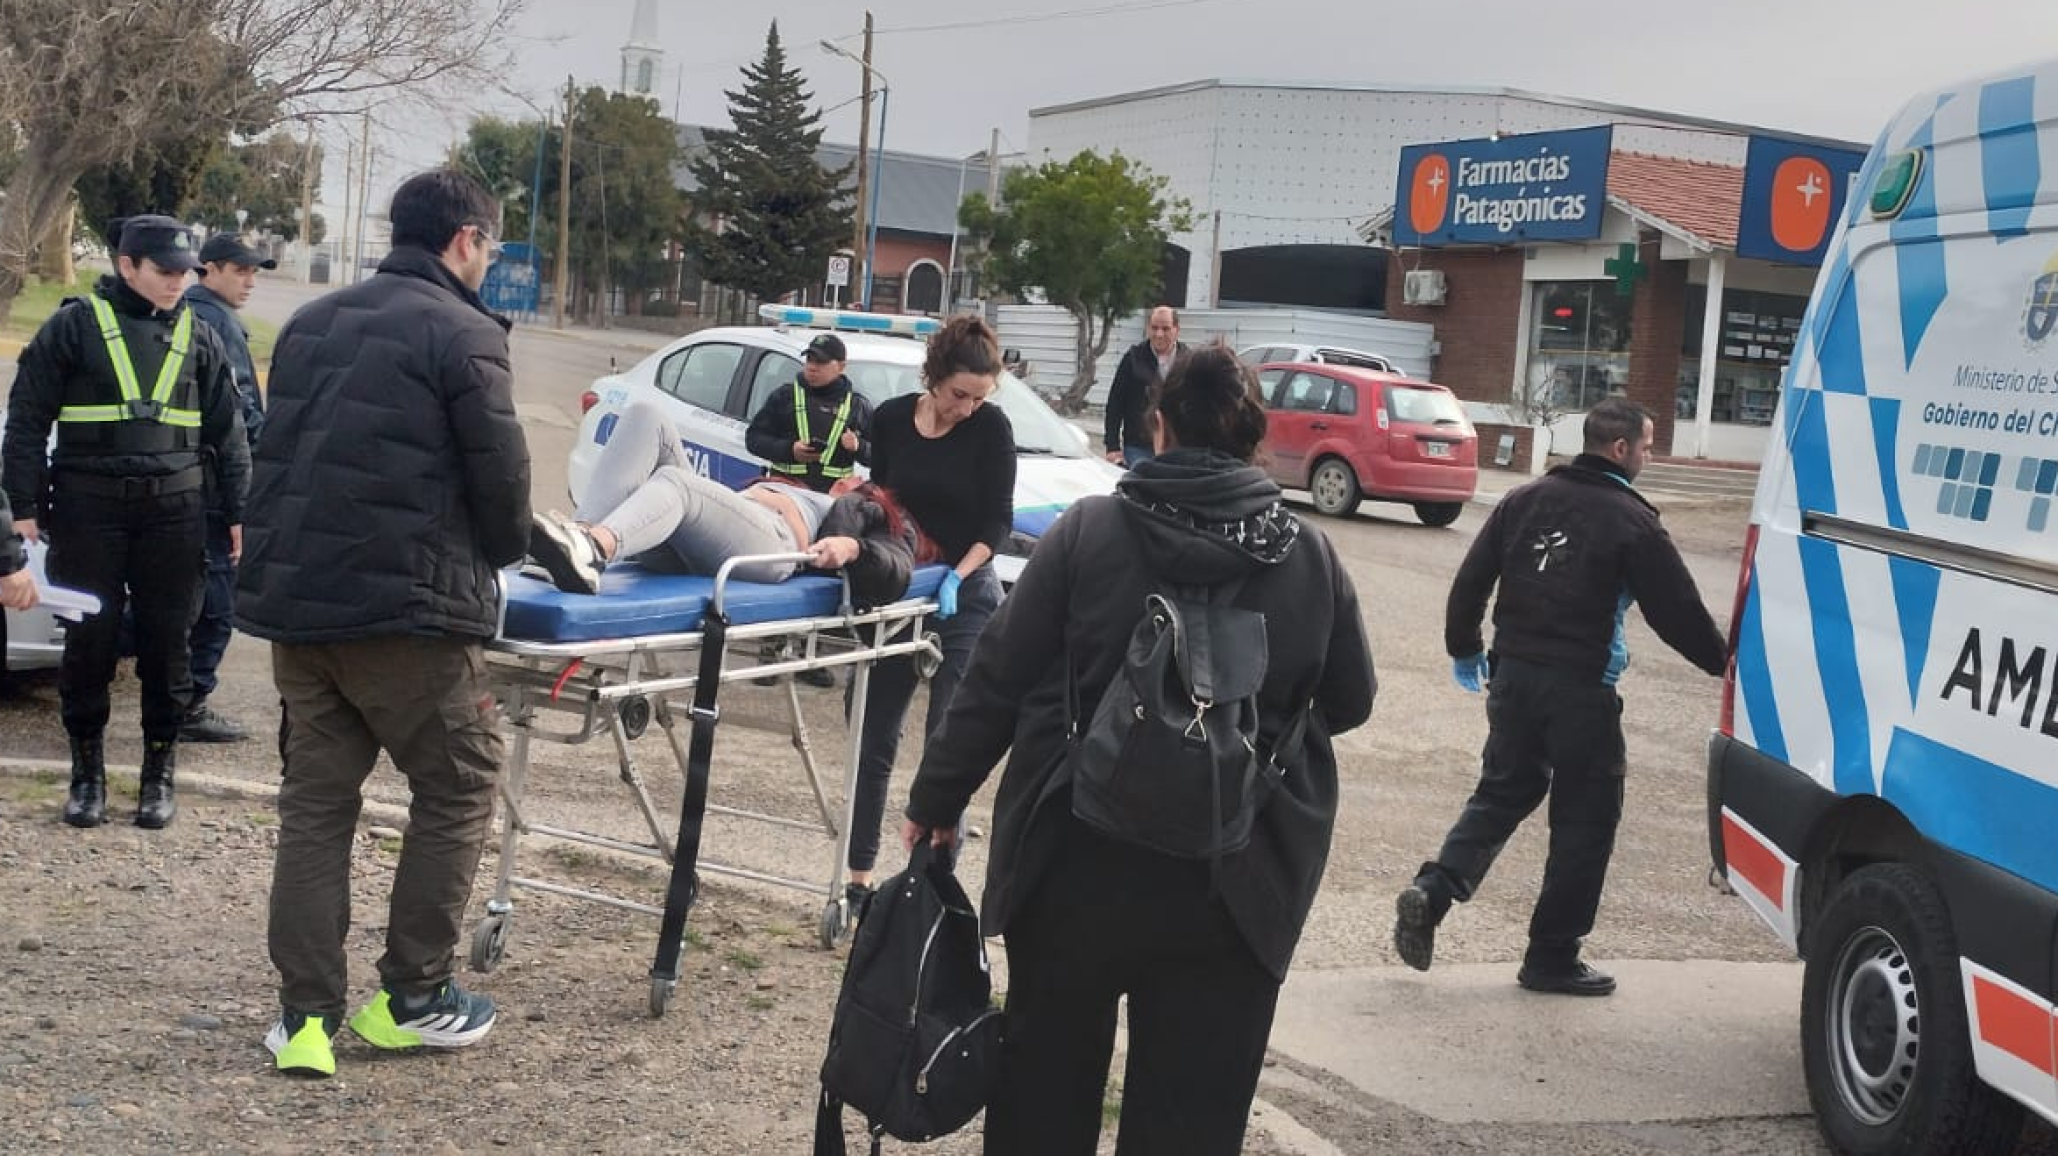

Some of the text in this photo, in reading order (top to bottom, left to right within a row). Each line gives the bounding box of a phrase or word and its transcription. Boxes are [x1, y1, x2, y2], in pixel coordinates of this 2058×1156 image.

[1458, 147, 1570, 187] Farmacias
[1454, 186, 1586, 232] Patagónicas
[1954, 365, 2024, 392] Ministerio
[2027, 367, 2048, 394] de
[1923, 402, 1999, 430] Gobierno
[2004, 408, 2035, 434] del
